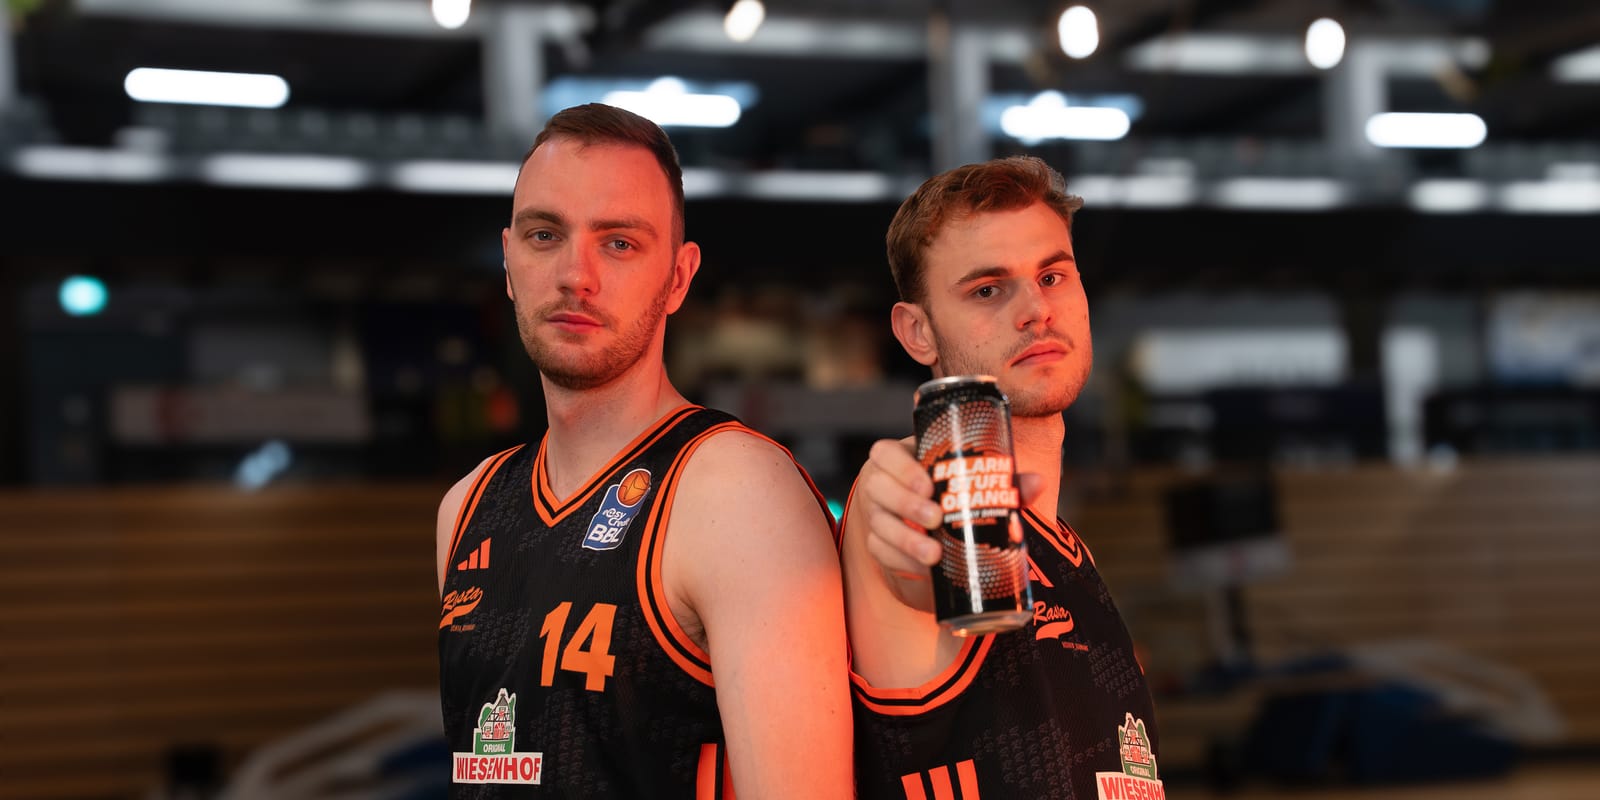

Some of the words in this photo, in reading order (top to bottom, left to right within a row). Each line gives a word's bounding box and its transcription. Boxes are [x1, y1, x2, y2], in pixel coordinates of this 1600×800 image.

[588, 524, 623, 543] BBL
[539, 601, 618, 693] 14
[456, 757, 541, 781] WIESENHOF
